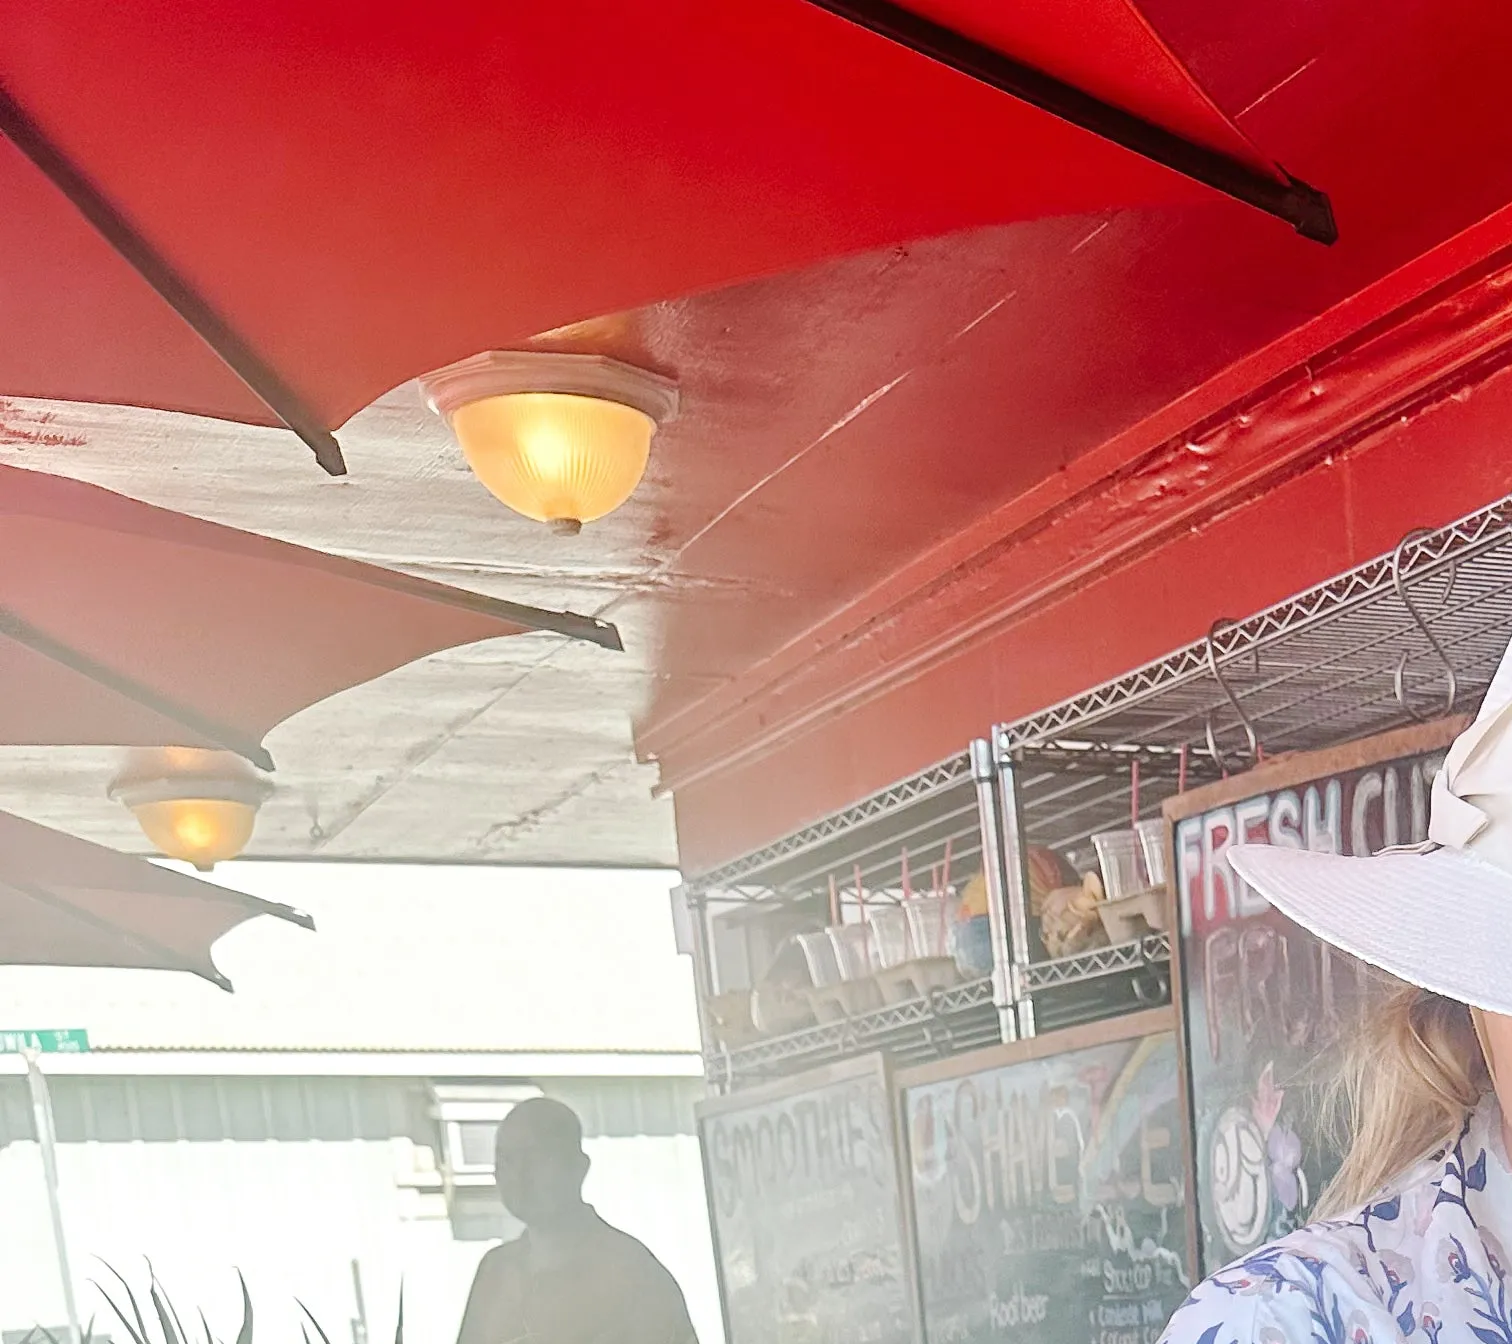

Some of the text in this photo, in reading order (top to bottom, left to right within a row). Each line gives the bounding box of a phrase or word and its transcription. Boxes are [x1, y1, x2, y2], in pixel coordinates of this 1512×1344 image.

[1176, 756, 1440, 939] FRESH CU
[713, 1080, 889, 1218] SMOOTHIES
[954, 1078, 1077, 1225] SHAVE
